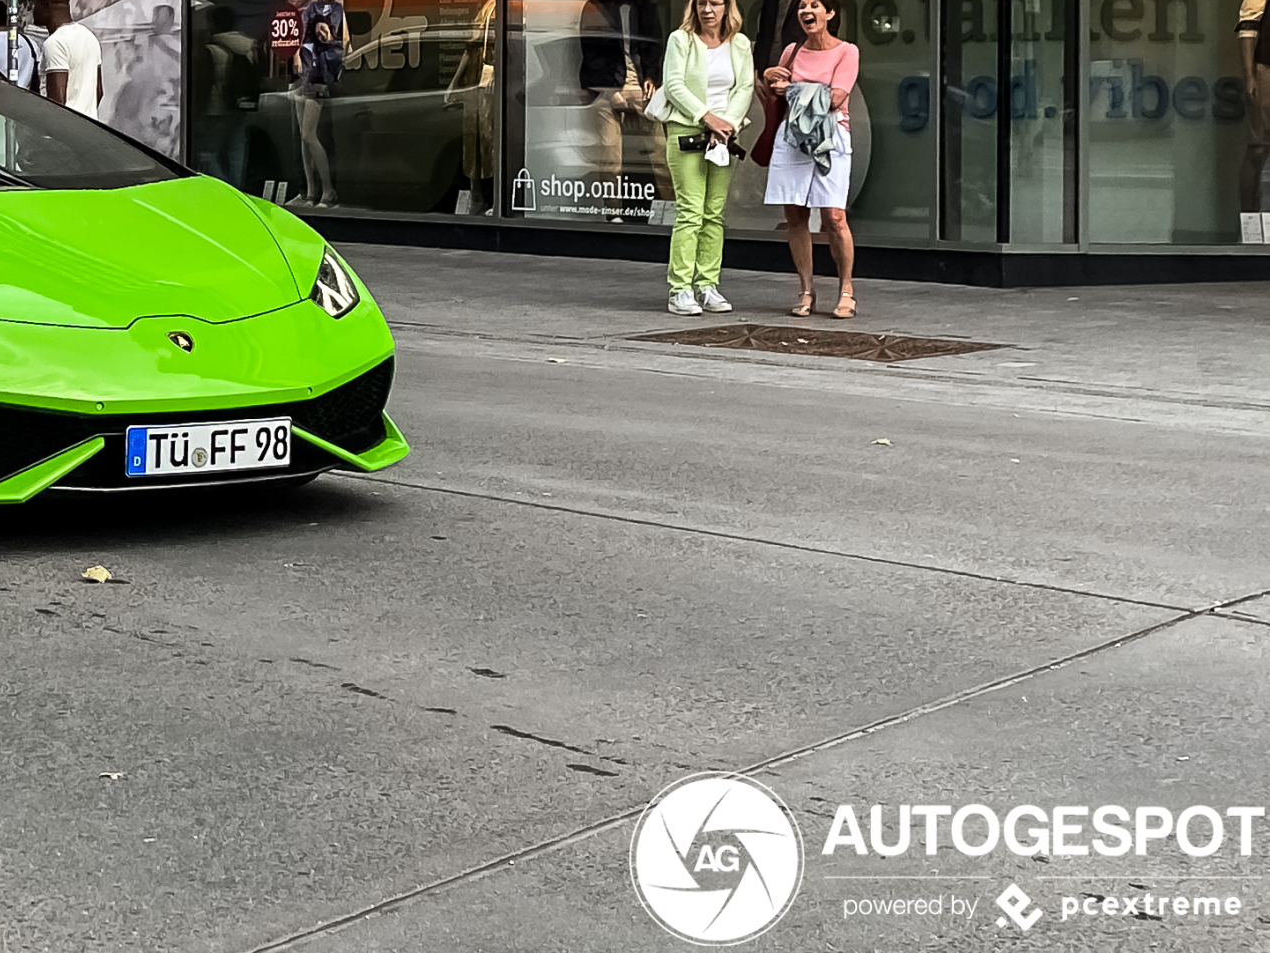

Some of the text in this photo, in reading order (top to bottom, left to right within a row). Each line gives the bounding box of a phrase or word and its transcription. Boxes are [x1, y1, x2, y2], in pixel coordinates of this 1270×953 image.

[271, 18, 299, 38] 30%
[540, 174, 656, 203] shop.online
[559, 205, 656, 218] www.mode-zinser.de/shop
[133, 425, 288, 469] D TÜ FF 98
